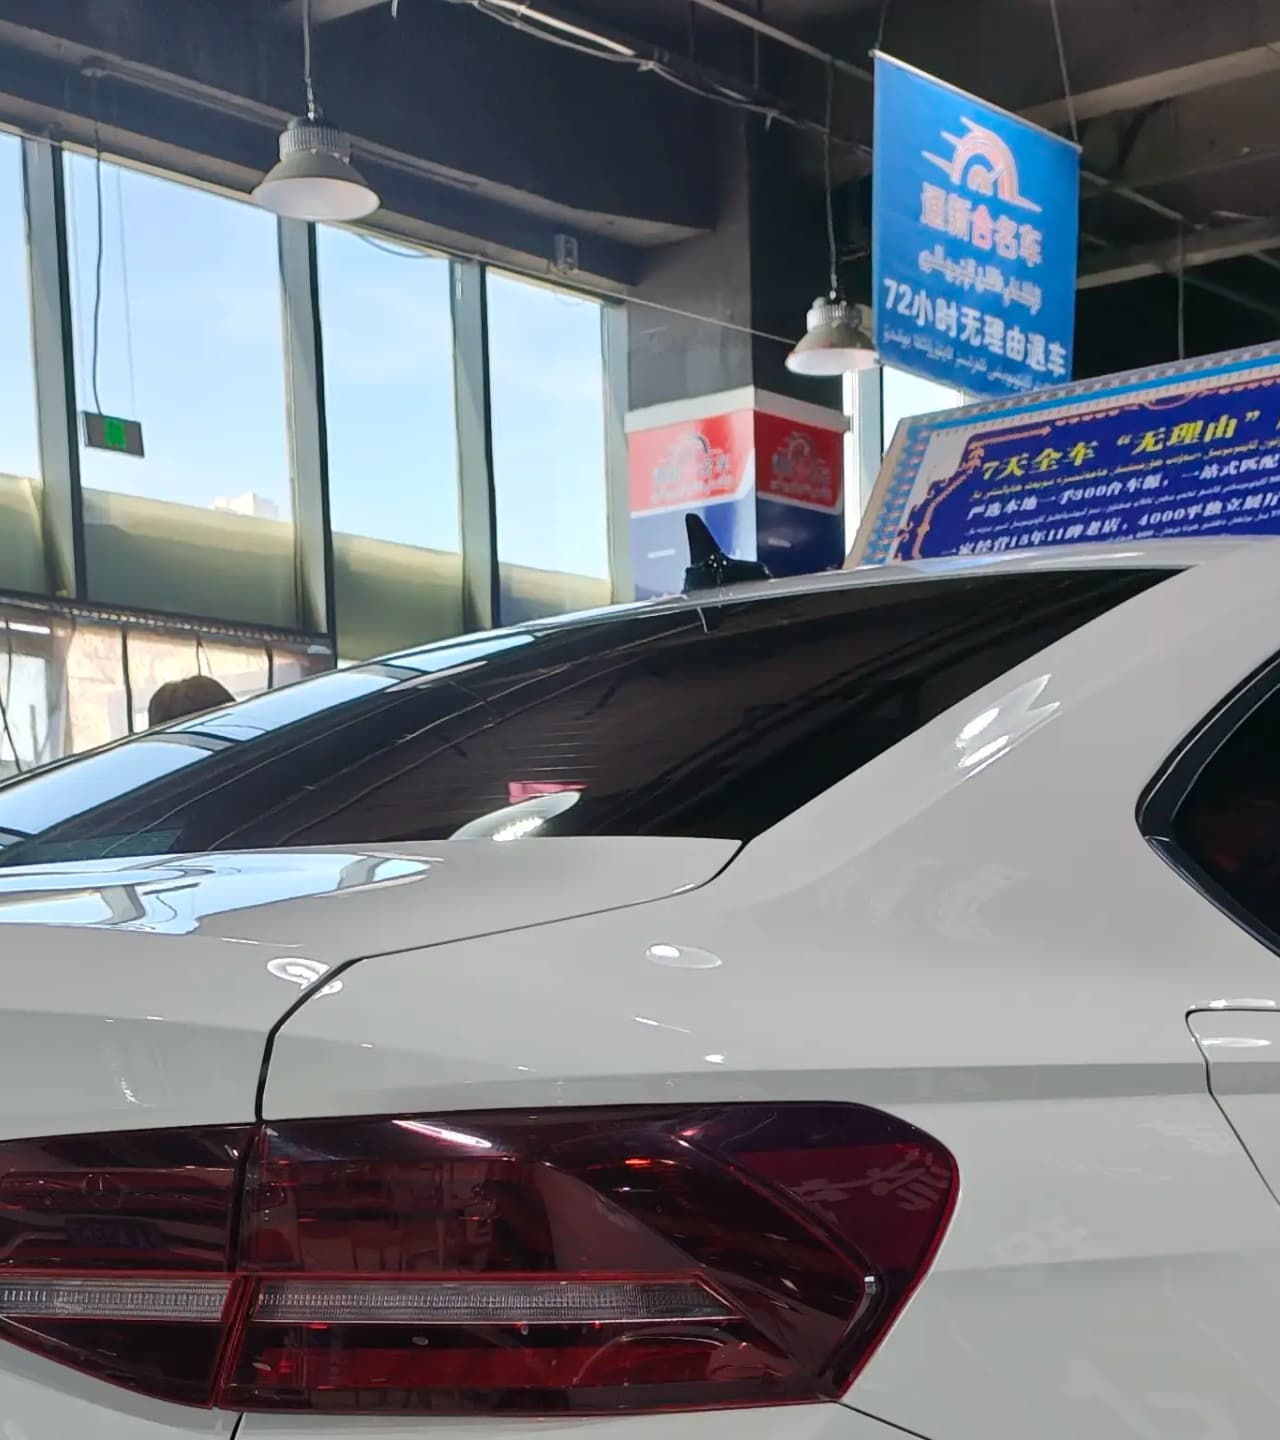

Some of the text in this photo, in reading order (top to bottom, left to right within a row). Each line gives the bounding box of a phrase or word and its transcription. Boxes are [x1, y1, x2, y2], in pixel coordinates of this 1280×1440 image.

[884, 278, 1067, 378] 72小时无理由退车
